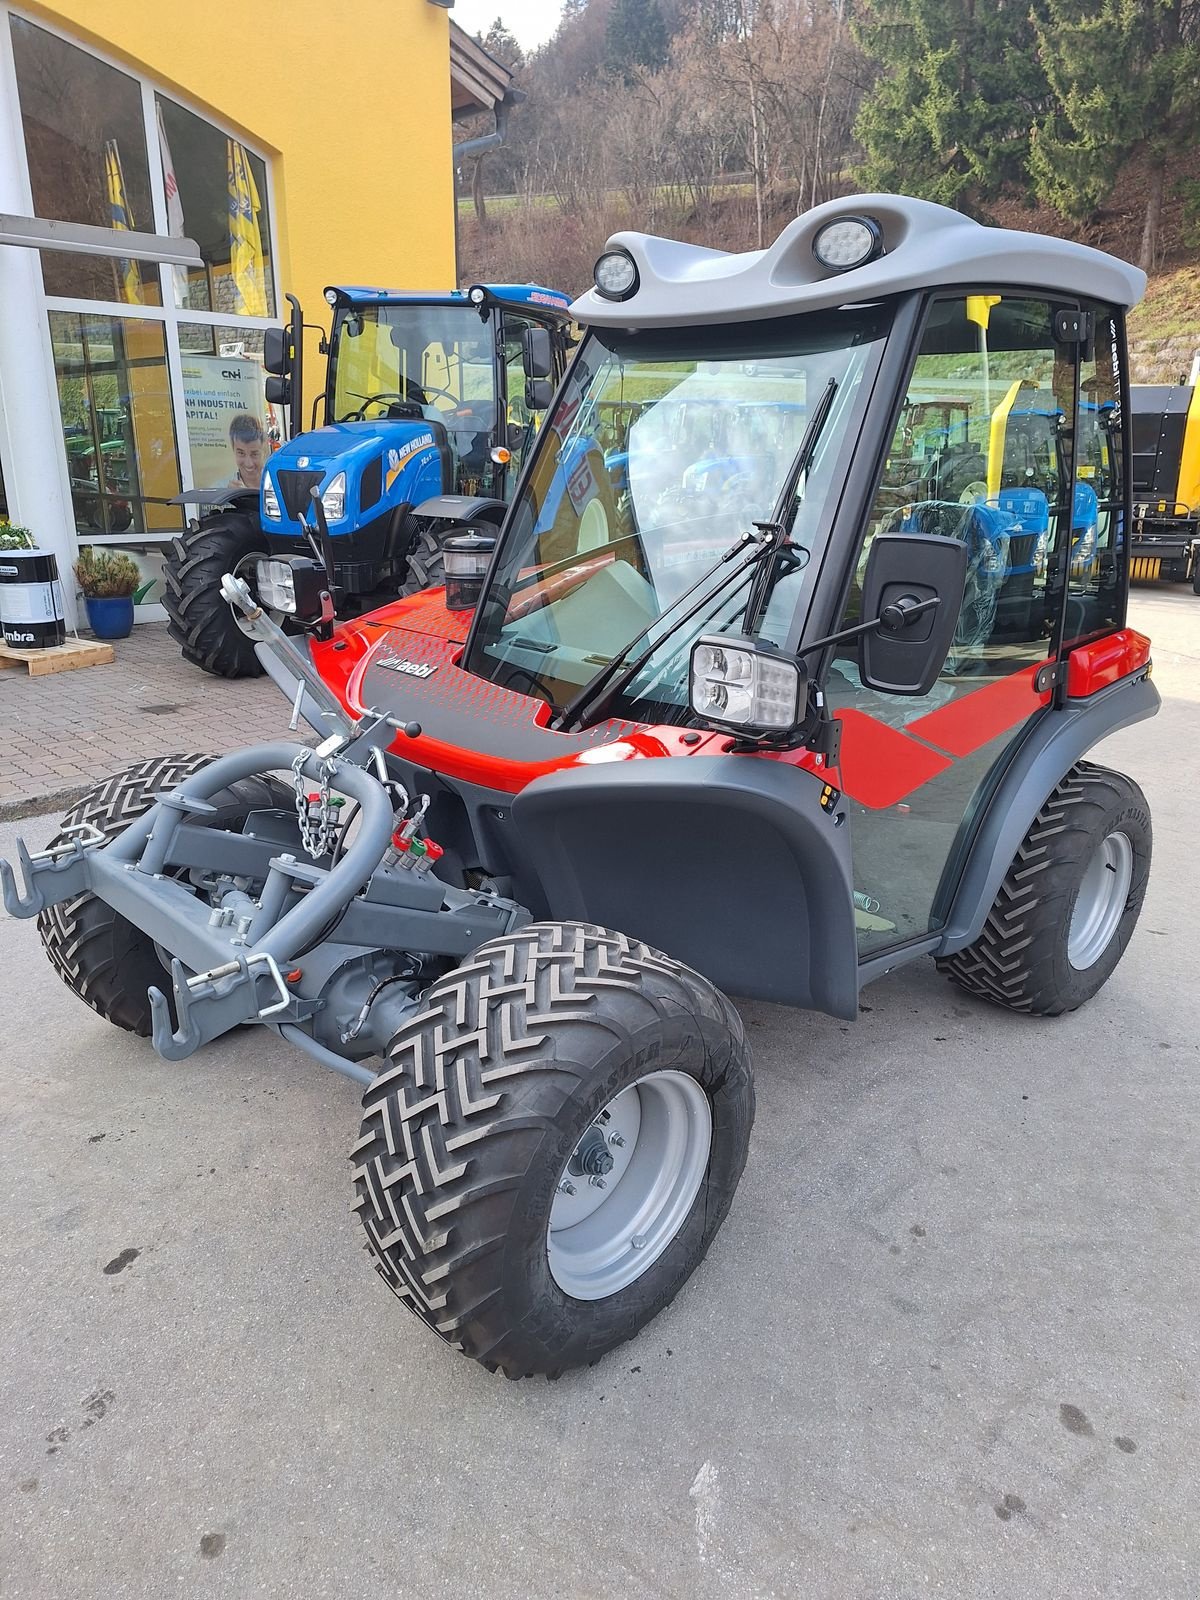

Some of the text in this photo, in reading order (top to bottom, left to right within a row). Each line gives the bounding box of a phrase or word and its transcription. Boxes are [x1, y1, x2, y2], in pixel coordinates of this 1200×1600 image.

[1111, 342, 1120, 376] aebi
[184, 399, 248, 409] NH INDUSTRIAL
[185, 410, 218, 420] APITAL!
[399, 433, 432, 459] NEW HOLLAND
[5, 630, 35, 642] mbra
[396, 661, 438, 678] aebi
